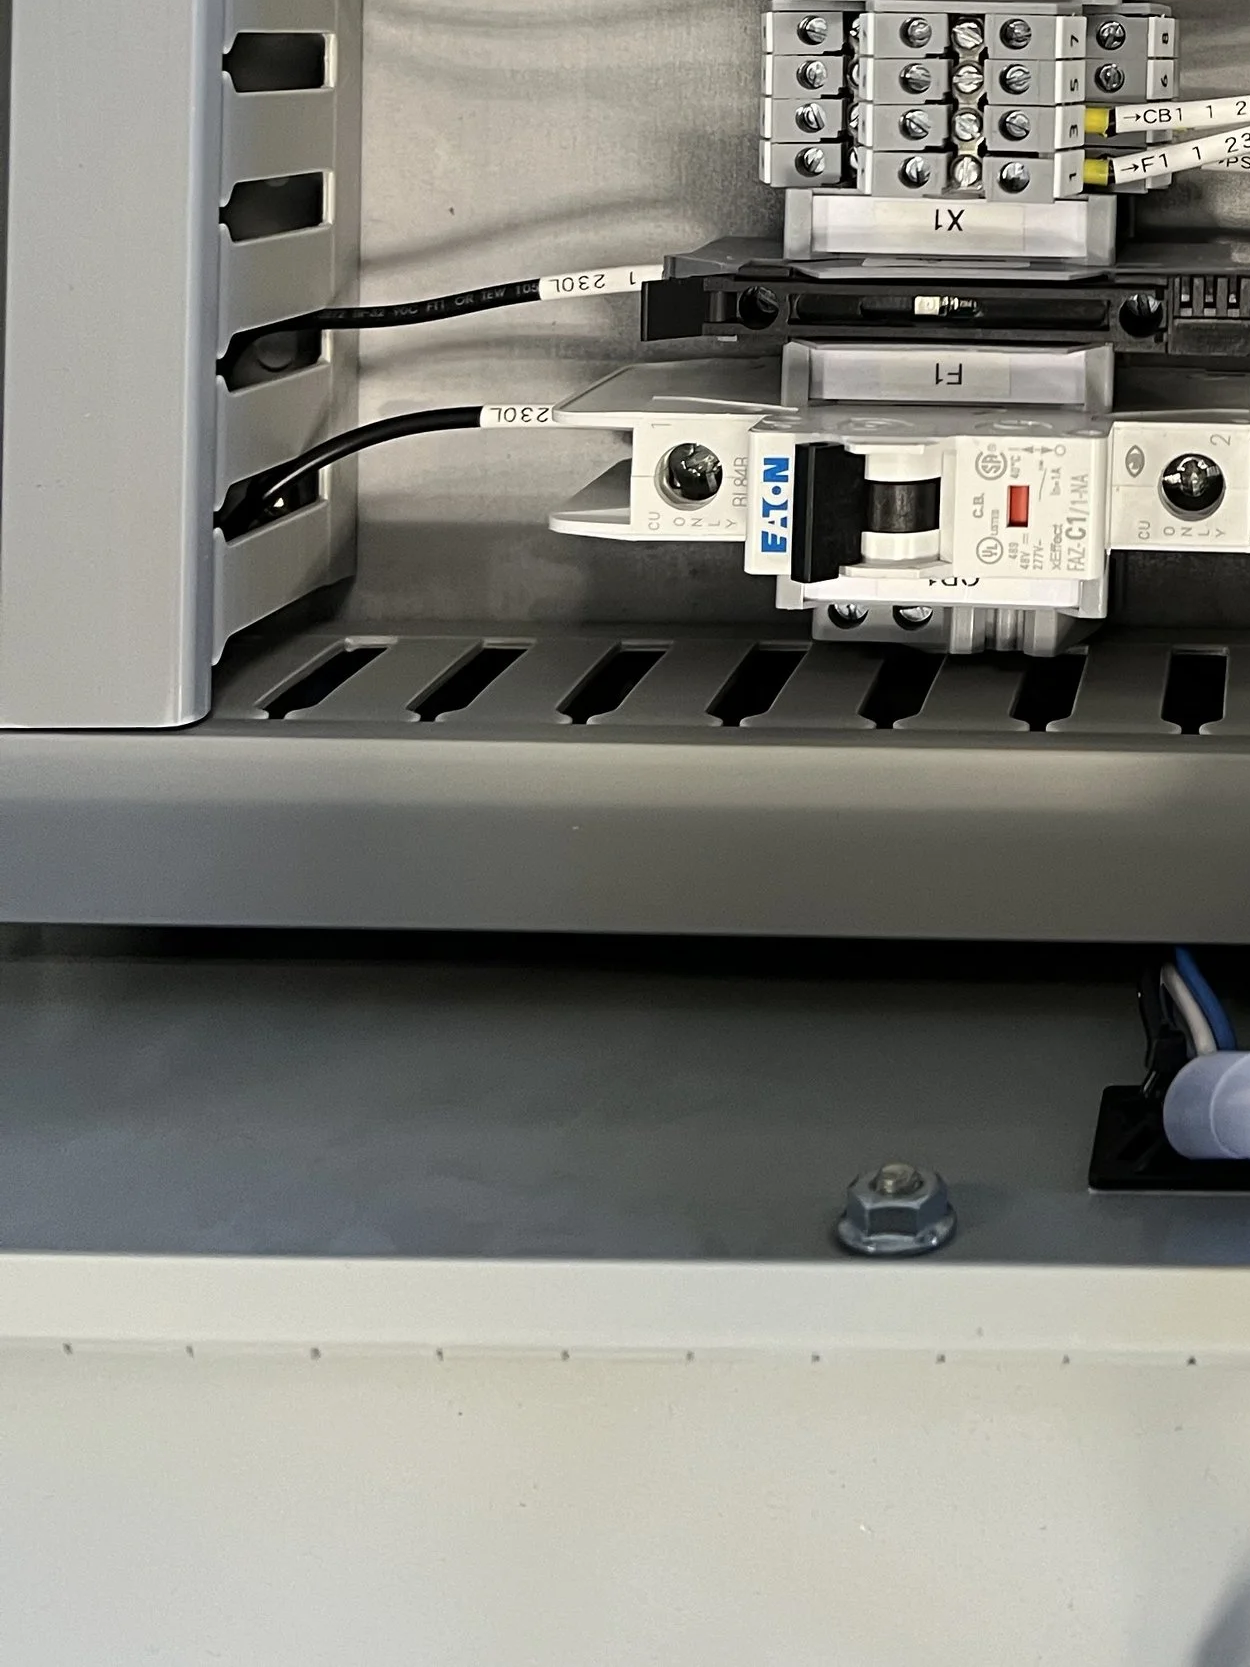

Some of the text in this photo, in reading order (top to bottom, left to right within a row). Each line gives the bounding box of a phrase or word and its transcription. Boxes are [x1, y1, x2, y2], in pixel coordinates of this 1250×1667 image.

[1143, 107, 1184, 124] CB1
[1206, 105, 1215, 119] 1
[1141, 153, 1170, 173] F1
[1191, 145, 1203, 162] 1
[934, 208, 966, 232] X1
[552, 270, 636, 293] 1 230L
[934, 361, 964, 386] F1
[490, 406, 550, 424] 230L
[1210, 432, 1233, 447] 2
[760, 457, 790, 554] EATON
[972, 492, 985, 519] C.B.
[648, 511, 661, 531] CU
[1065, 473, 1091, 573] FAZ-C1/1-NA
[1138, 520, 1151, 541] CU
